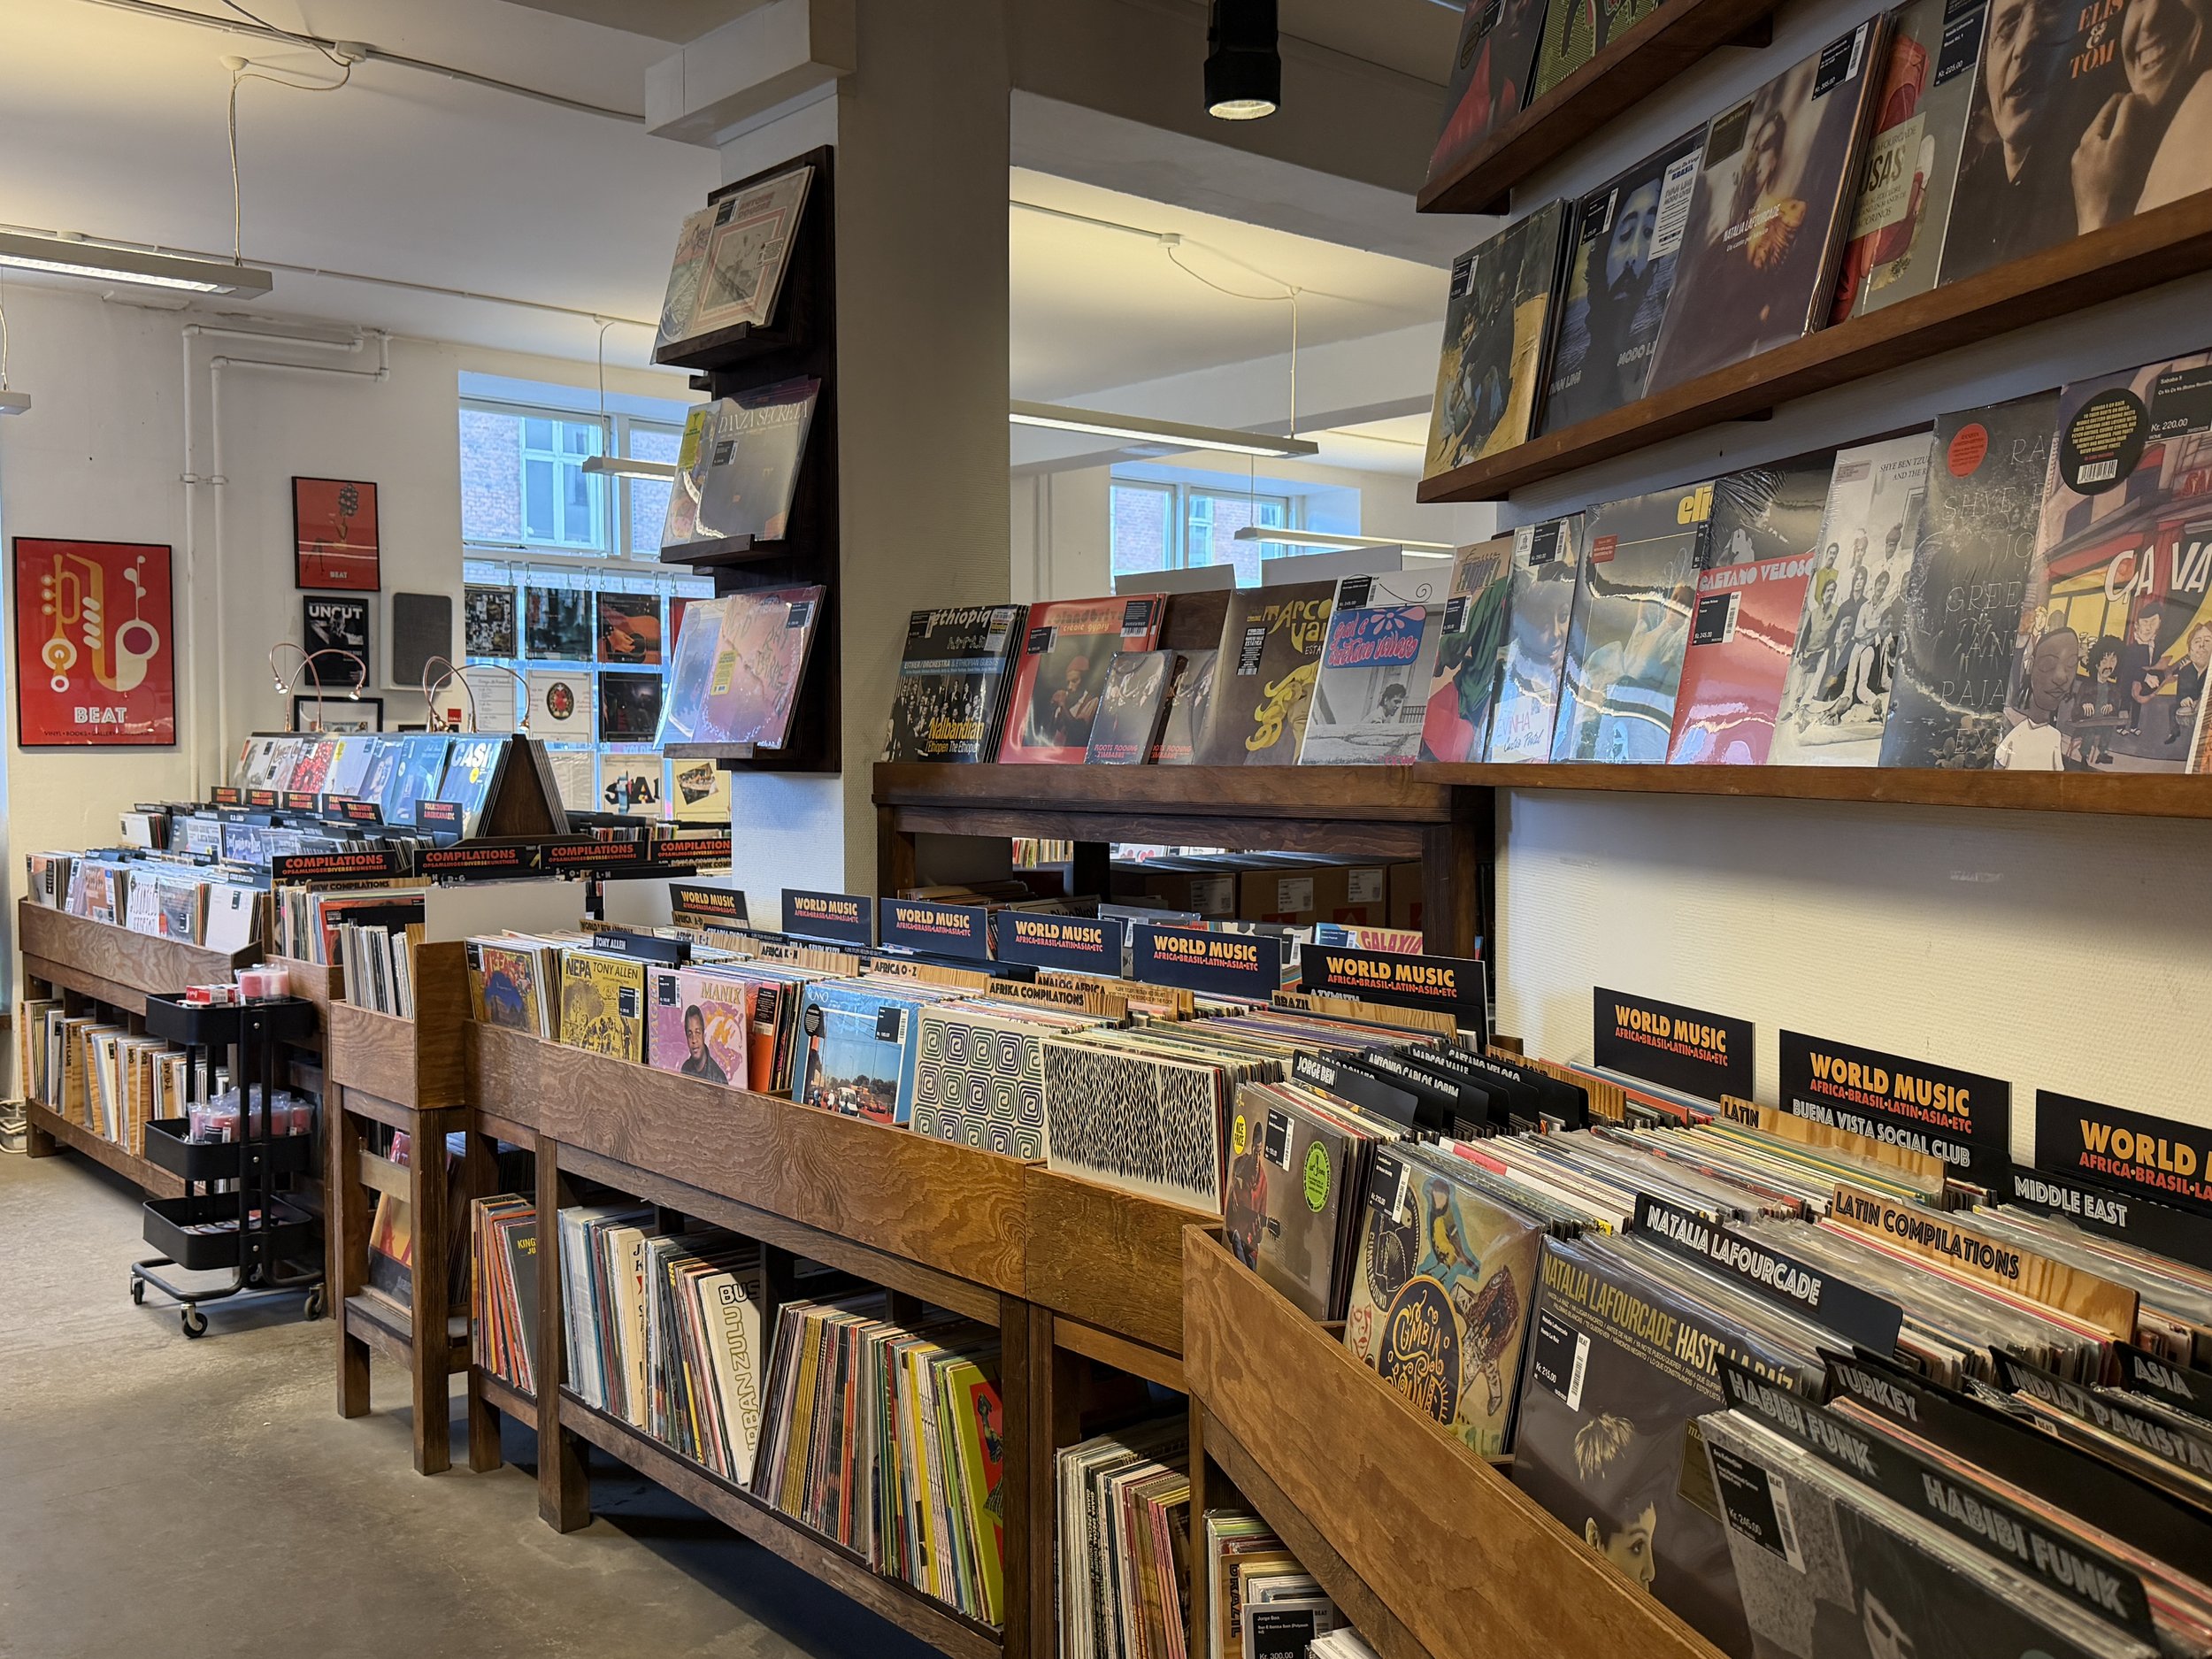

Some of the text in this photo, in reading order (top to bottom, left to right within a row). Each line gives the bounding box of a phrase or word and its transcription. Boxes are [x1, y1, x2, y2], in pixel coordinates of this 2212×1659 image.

[2070, 39, 2116, 79] TOM
[2162, 419, 2188, 428] 220.00
[309, 605, 364, 619] UNCUT
[74, 706, 127, 724] BEAT
[929, 718, 985, 741] Nalbandian
[285, 854, 384, 869] COMPILATIONS
[426, 849, 516, 863] COMPILATIONS
[551, 844, 634, 856] COMPILATIONS
[680, 890, 735, 908] WORLD MUSIC
[794, 896, 858, 916] WORLD MUSIC
[674, 913, 692, 925] AFRICA
[896, 908, 970, 928] WORLD MUSIC
[595, 936, 626, 950] TONY ALLEN
[1015, 920, 1102, 943] WORLD MUSIC
[761, 945, 783, 958] AFRICA
[1153, 935, 1257, 963] WORLD MUSIC
[565, 957, 640, 980] NEPA TONY ALLEN
[874, 961, 900, 975] AFRICA
[1326, 956, 1455, 987] WORLD MUSIC
[701, 981, 741, 1004] MANIX
[989, 982, 1085, 1007] AFRIKA COMPILATIONS
[1274, 995, 1311, 1010] BRAZIL
[1615, 1004, 1727, 1053] WORLD MUSIC
[1297, 1056, 1337, 1087] JORGE BEN
[1809, 1051, 1970, 1118] WORLD MUSIC
[1724, 1101, 1760, 1128] LATIN
[1792, 1098, 1971, 1168] BUENA VISTA SOCIAL CLUB
[2079, 1118, 2198, 1177] WORLD
[2014, 1175, 2129, 1228] MIDDLE EAST
[1835, 1191, 2020, 1280] LATIN COMPILATIONS
[1647, 1204, 1823, 1307] NATALIA LAFOURCADE
[1541, 1252, 1590, 1306] NATALIA
[1588, 1278, 1678, 1353] LAFOURCADE
[723, 1305, 751, 1372] ZULU
[2133, 1356, 2194, 1401] ASIA
[1833, 1361, 1918, 1423] TURKEY
[1727, 1369, 1879, 1479] HABIBI FUNK
[1921, 1472, 2130, 1620] HABIBI FUNK
